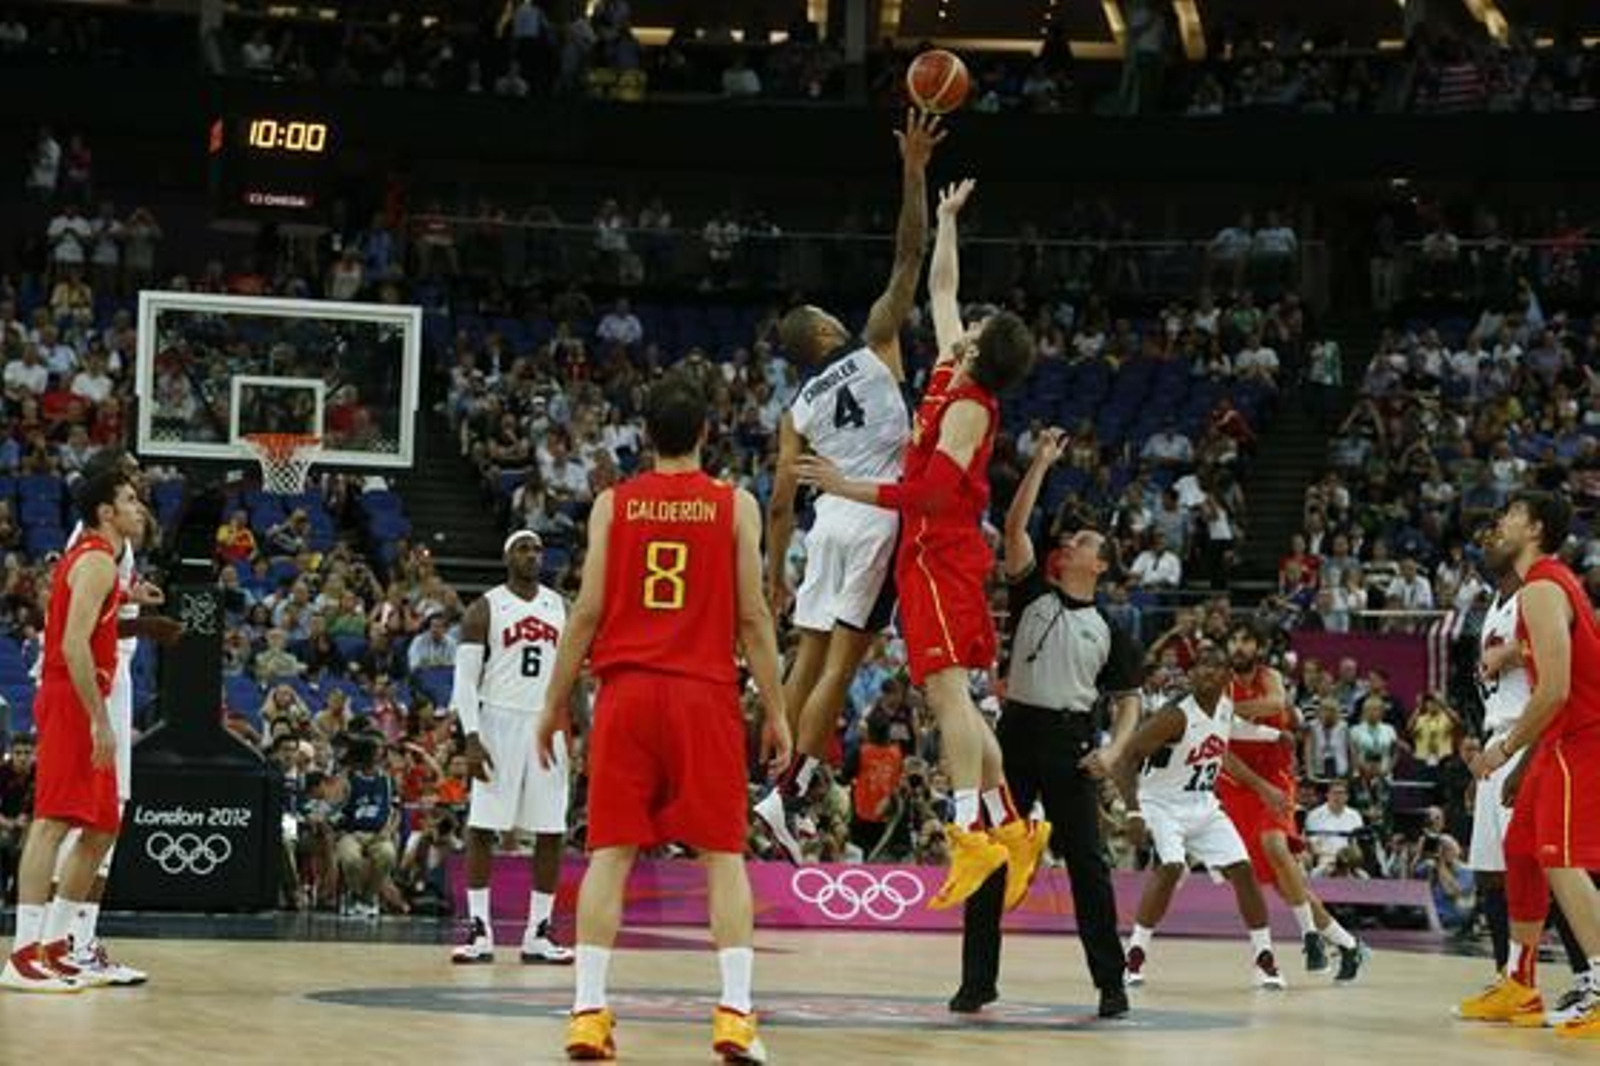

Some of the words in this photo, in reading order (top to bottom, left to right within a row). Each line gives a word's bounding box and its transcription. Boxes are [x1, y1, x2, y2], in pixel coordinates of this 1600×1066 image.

[249, 120, 326, 151] 10:00
[834, 384, 865, 428] 4
[627, 498, 717, 521] CALDERÓN
[644, 541, 688, 609] 8
[503, 615, 559, 649] USA
[521, 645, 542, 677] 6
[133, 804, 205, 826] London
[207, 806, 251, 826] 2012
